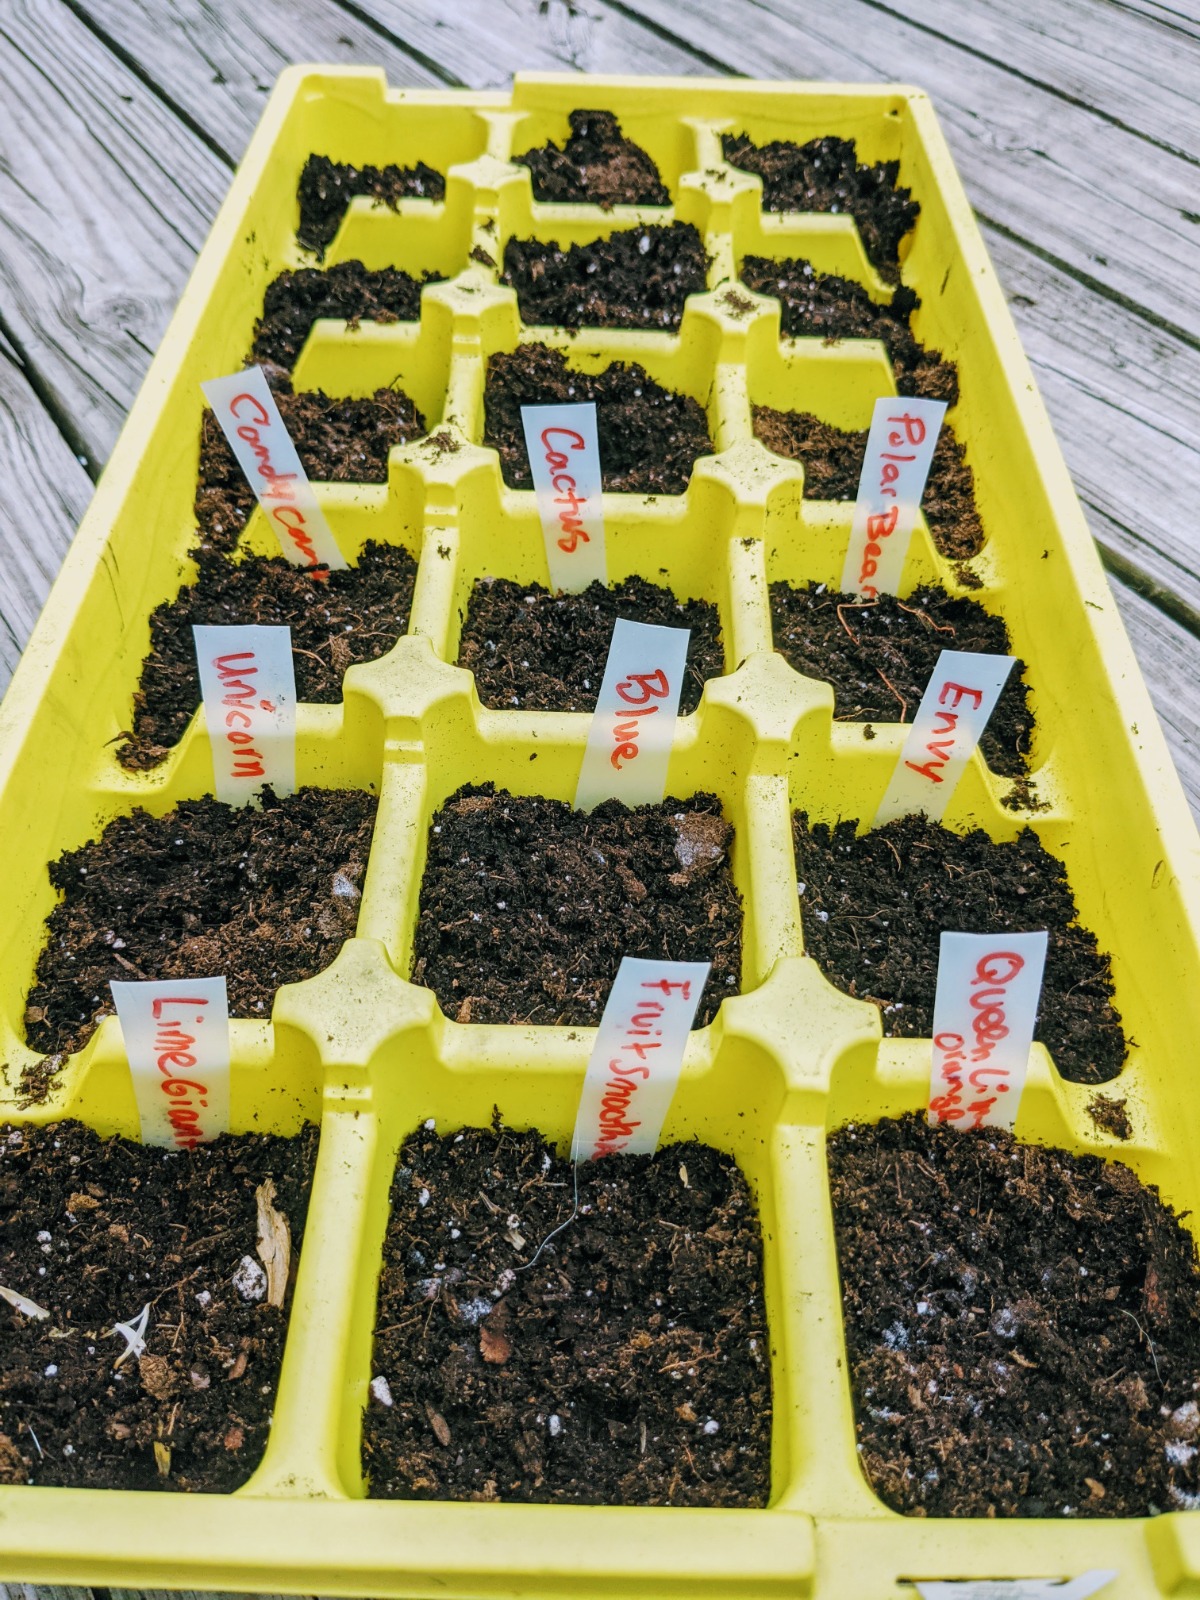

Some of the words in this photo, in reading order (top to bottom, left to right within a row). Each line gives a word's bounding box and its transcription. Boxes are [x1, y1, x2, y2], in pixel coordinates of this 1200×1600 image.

[229, 393, 298, 500] Candy
[541, 427, 590, 553] Cactus
[880, 413, 926, 497] Polar
[859, 506, 899, 599] Bear
[211, 652, 276, 777] Unicorn
[611, 669, 669, 770] Blue
[905, 681, 983, 783] Envy
[152, 998, 209, 1077] Lime
[621, 979, 691, 1059] Fruit
[969, 951, 1025, 1062] Queen
[161, 1078, 208, 1150] Giant
[929, 1032, 965, 1123] Orange
